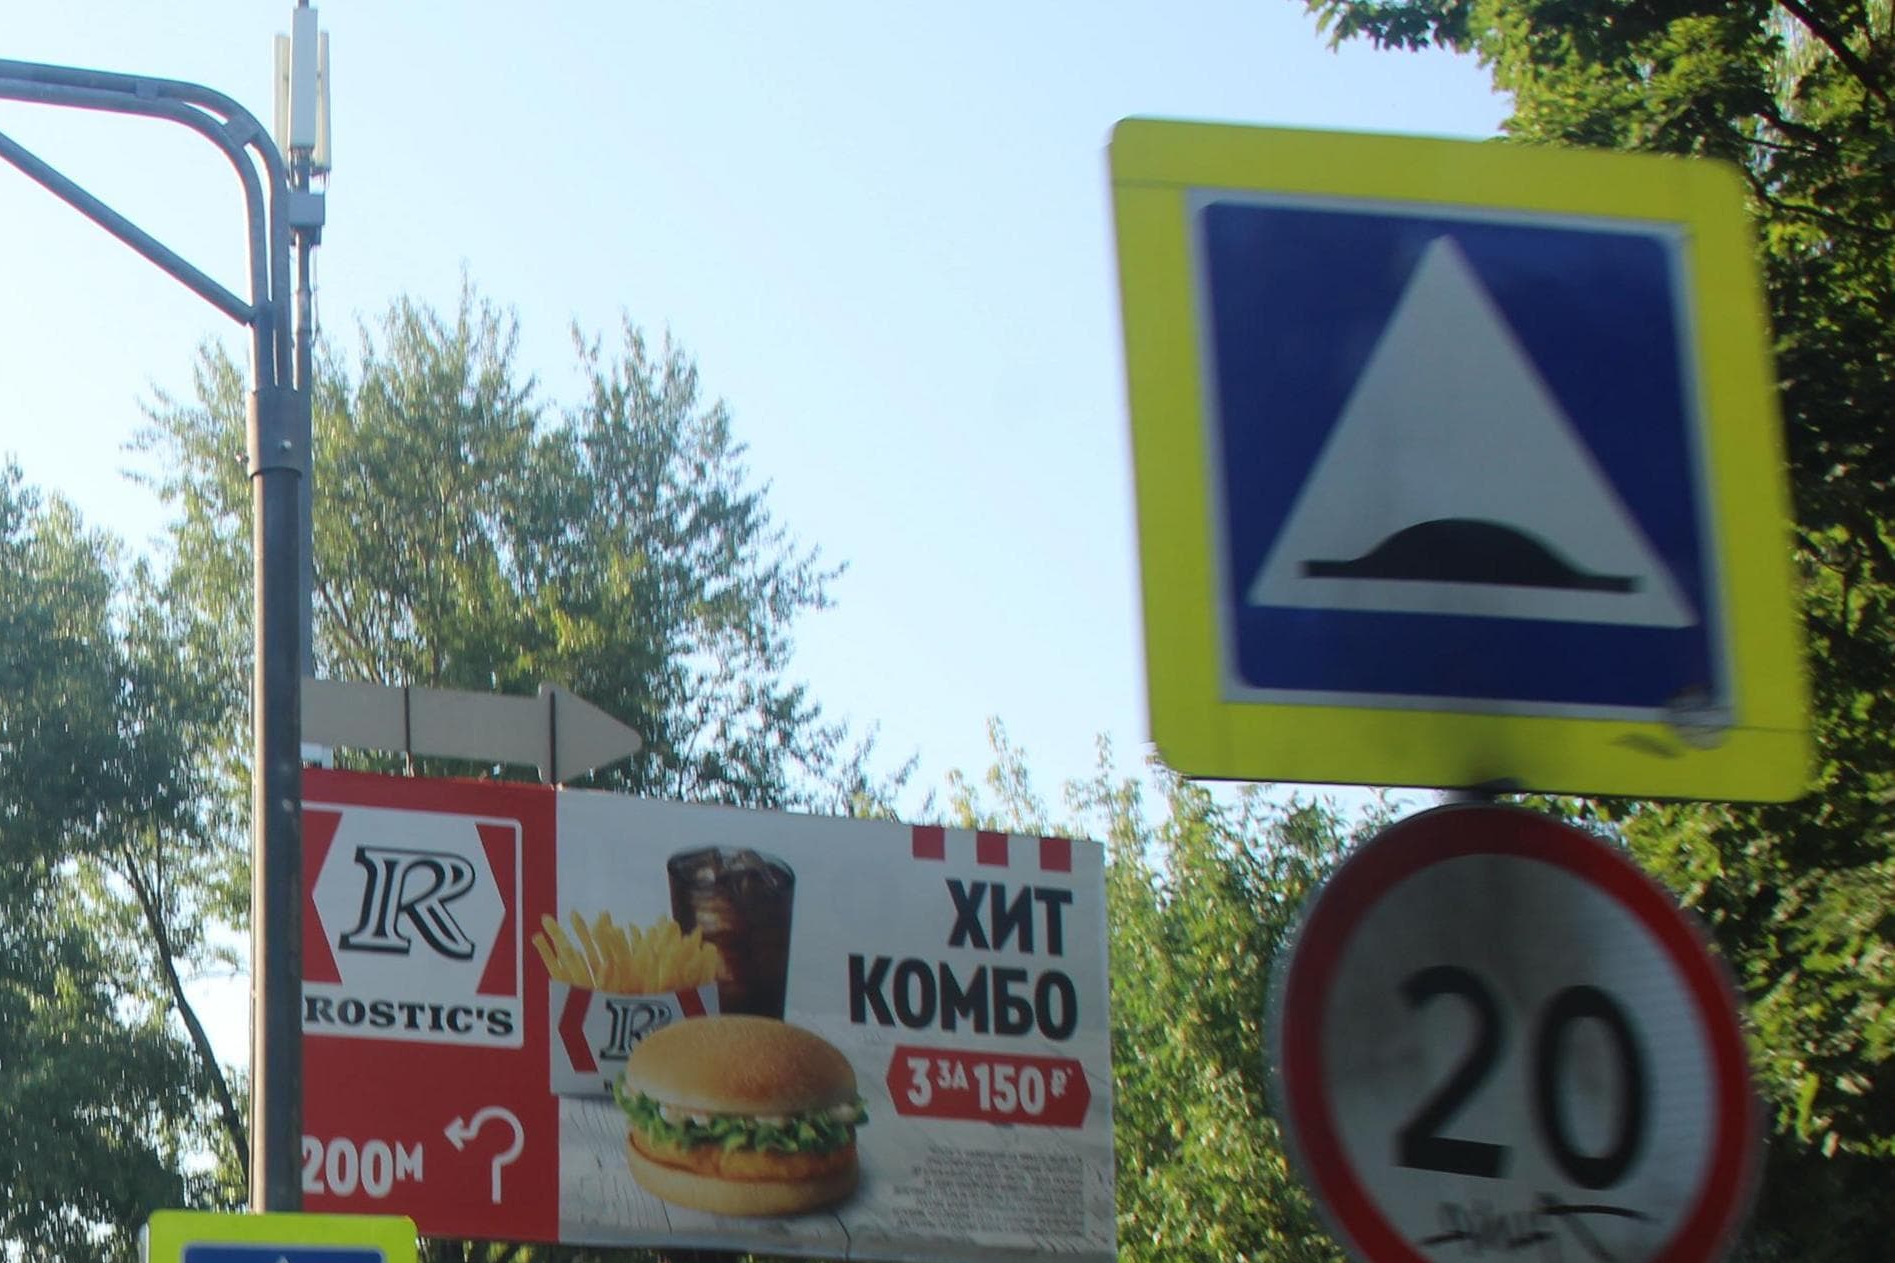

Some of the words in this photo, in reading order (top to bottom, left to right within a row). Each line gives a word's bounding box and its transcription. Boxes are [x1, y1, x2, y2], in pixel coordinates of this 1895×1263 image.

[339, 844, 476, 963] R
[945, 878, 1073, 957] ХИТ
[304, 995, 514, 1036] ROSTIC'S
[848, 953, 1078, 1042] КОМБО
[1395, 965, 1652, 1191] 20
